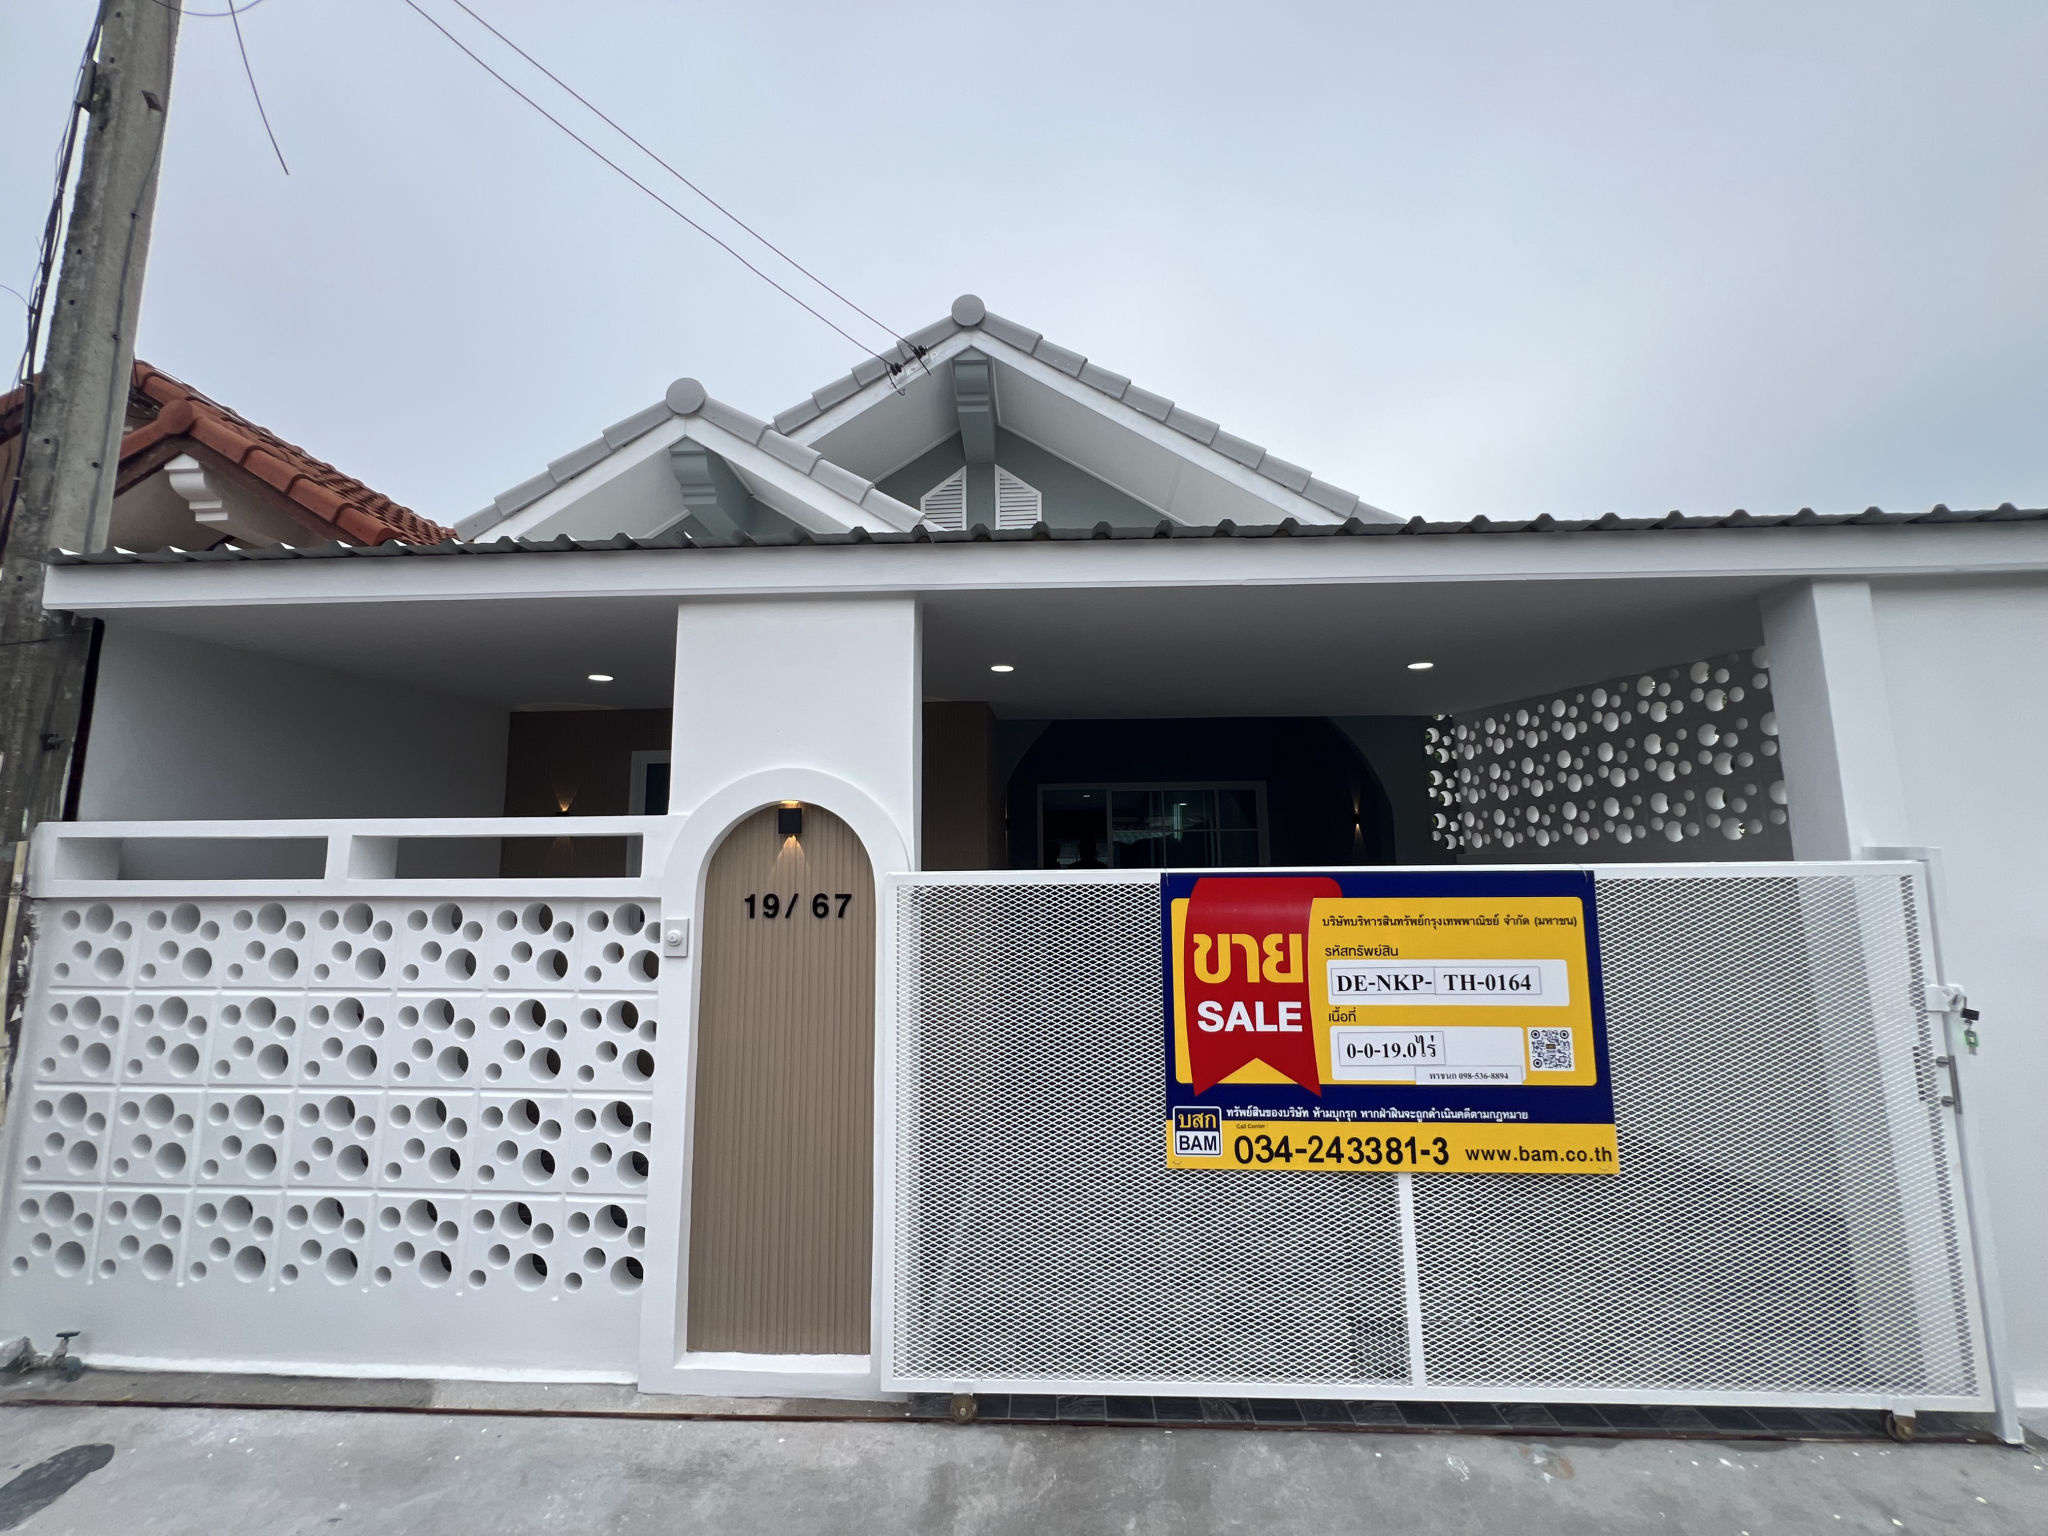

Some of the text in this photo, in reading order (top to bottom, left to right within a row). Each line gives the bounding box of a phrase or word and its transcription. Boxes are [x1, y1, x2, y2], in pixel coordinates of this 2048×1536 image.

[1322, 914, 1577, 930] บริษัทบริหารสินทรัพย์กรุงเทพพาณิชย์ จำกัด (มหาชน)
[1193, 933, 1304, 984] ขาย
[1325, 944, 1398, 957] รหัสทรัพย์สิน
[1337, 974, 1532, 992] DE-NKP- TH-0164
[1197, 1000, 1303, 1032] SALE
[1328, 1007, 1357, 1023] เนื้อที่
[1178, 1112, 1217, 1129] บสก
[1226, 1105, 1529, 1122] ทรัพย์สินของบริษัท ห้ามบุกรุก หากฝ่าฝืนจะถูกดำเนินคดีตามกฎหมาย
[1179, 1135, 1217, 1151] BAM
[1234, 1135, 1613, 1165] 034-243381-3 www.bam.co.th
